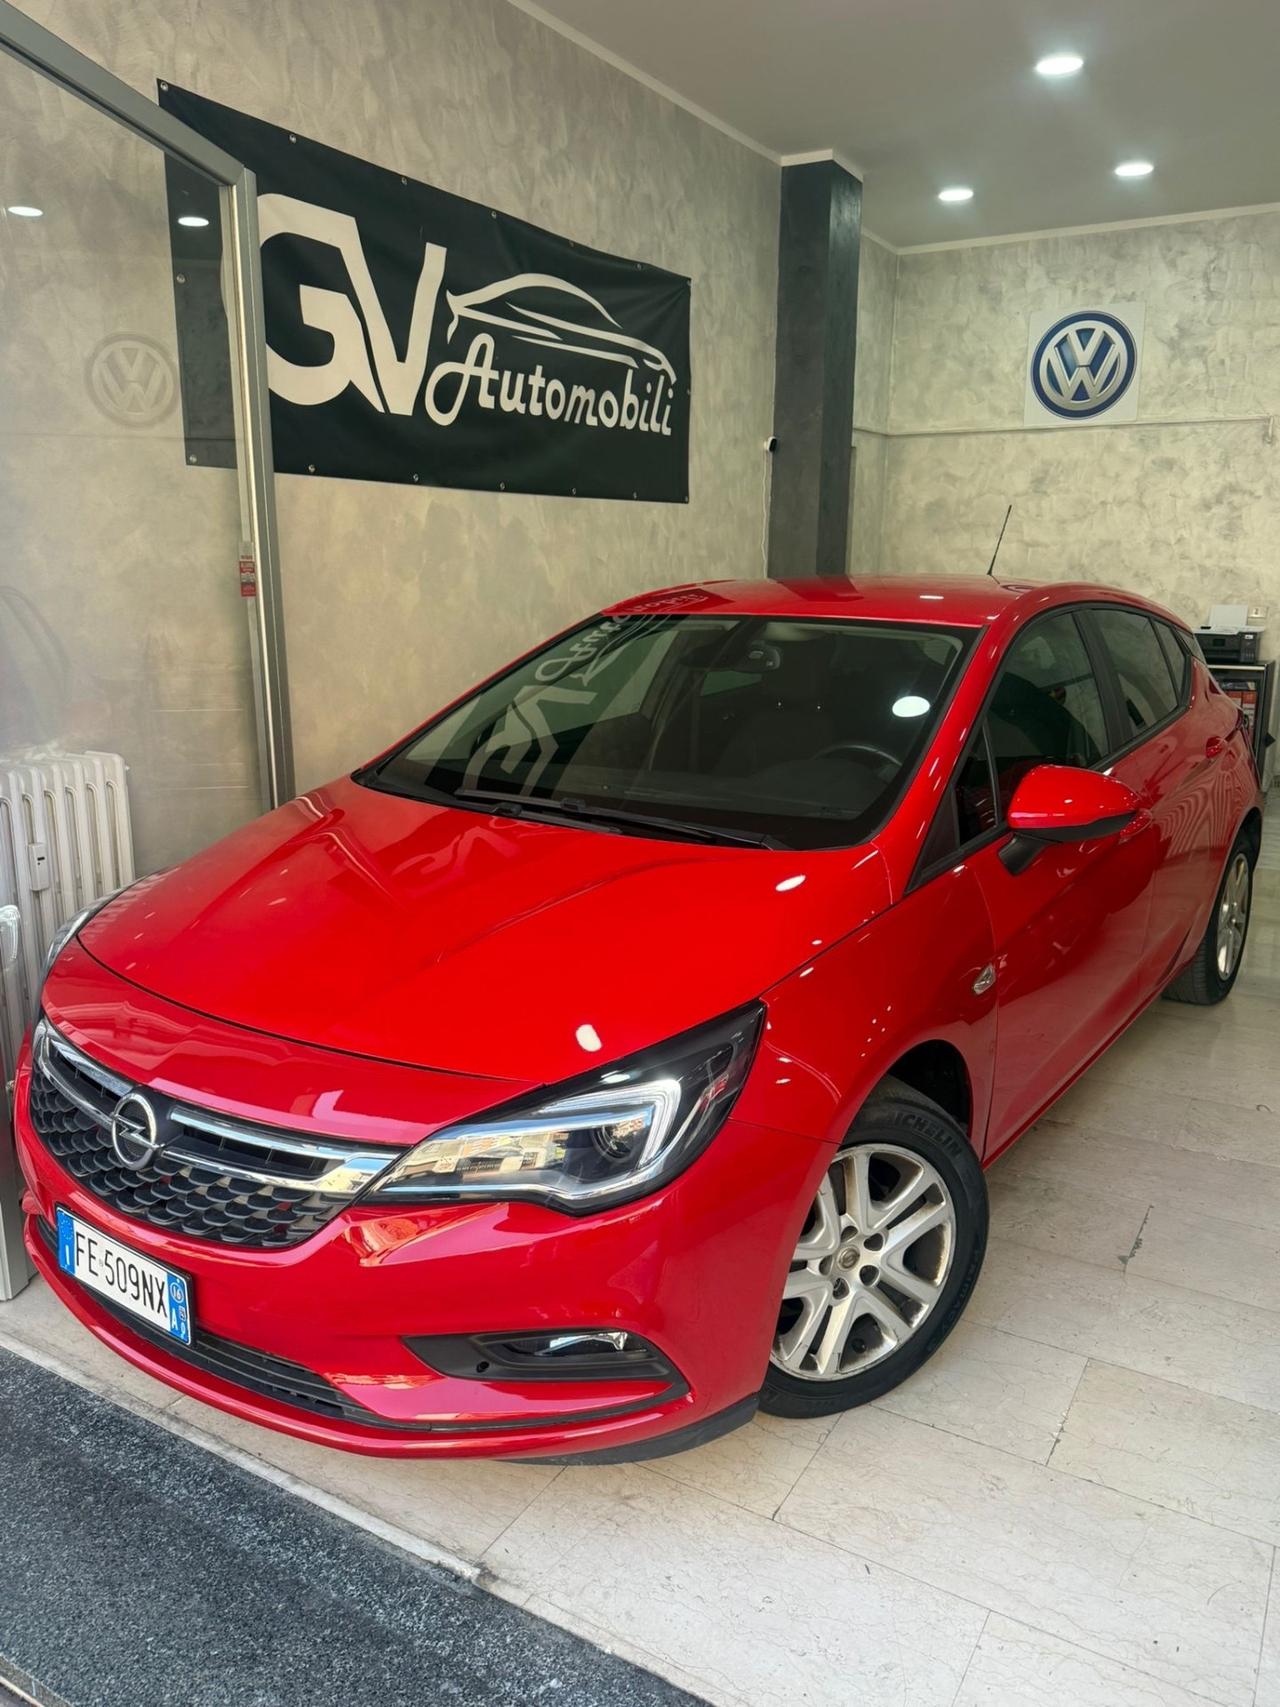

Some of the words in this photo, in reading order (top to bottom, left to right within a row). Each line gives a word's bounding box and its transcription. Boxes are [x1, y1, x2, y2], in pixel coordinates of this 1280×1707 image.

[256, 193, 447, 416] GV
[425, 333, 672, 436] Automobili
[76, 1231, 99, 1277] FE
[105, 1249, 168, 1318] 509NX
